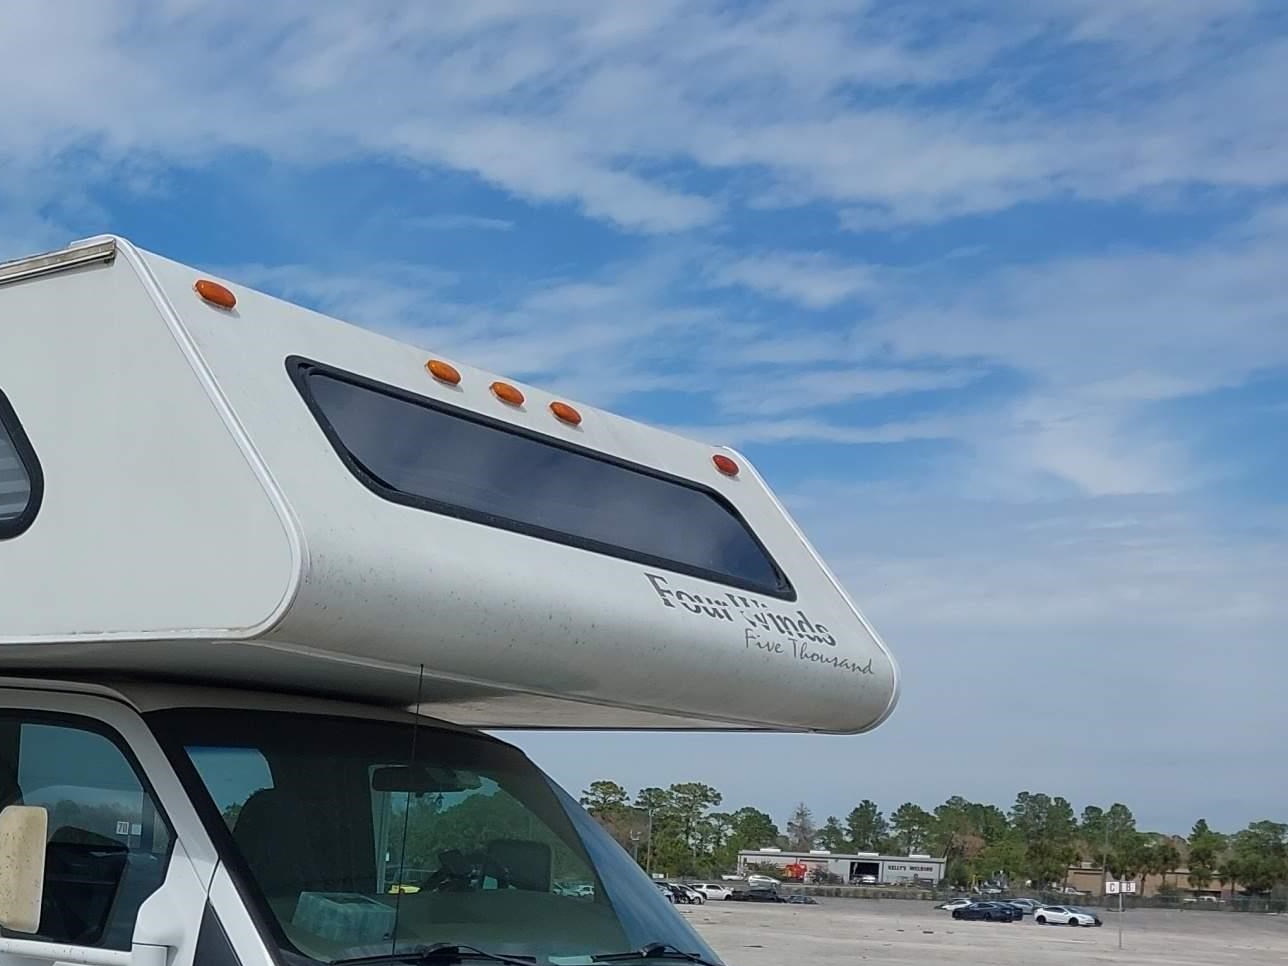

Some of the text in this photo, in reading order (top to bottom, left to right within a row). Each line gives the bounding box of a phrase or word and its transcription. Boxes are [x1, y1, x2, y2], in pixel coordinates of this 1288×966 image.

[644, 572, 837, 646] Four Winds
[744, 628, 875, 675] Five Thousand
